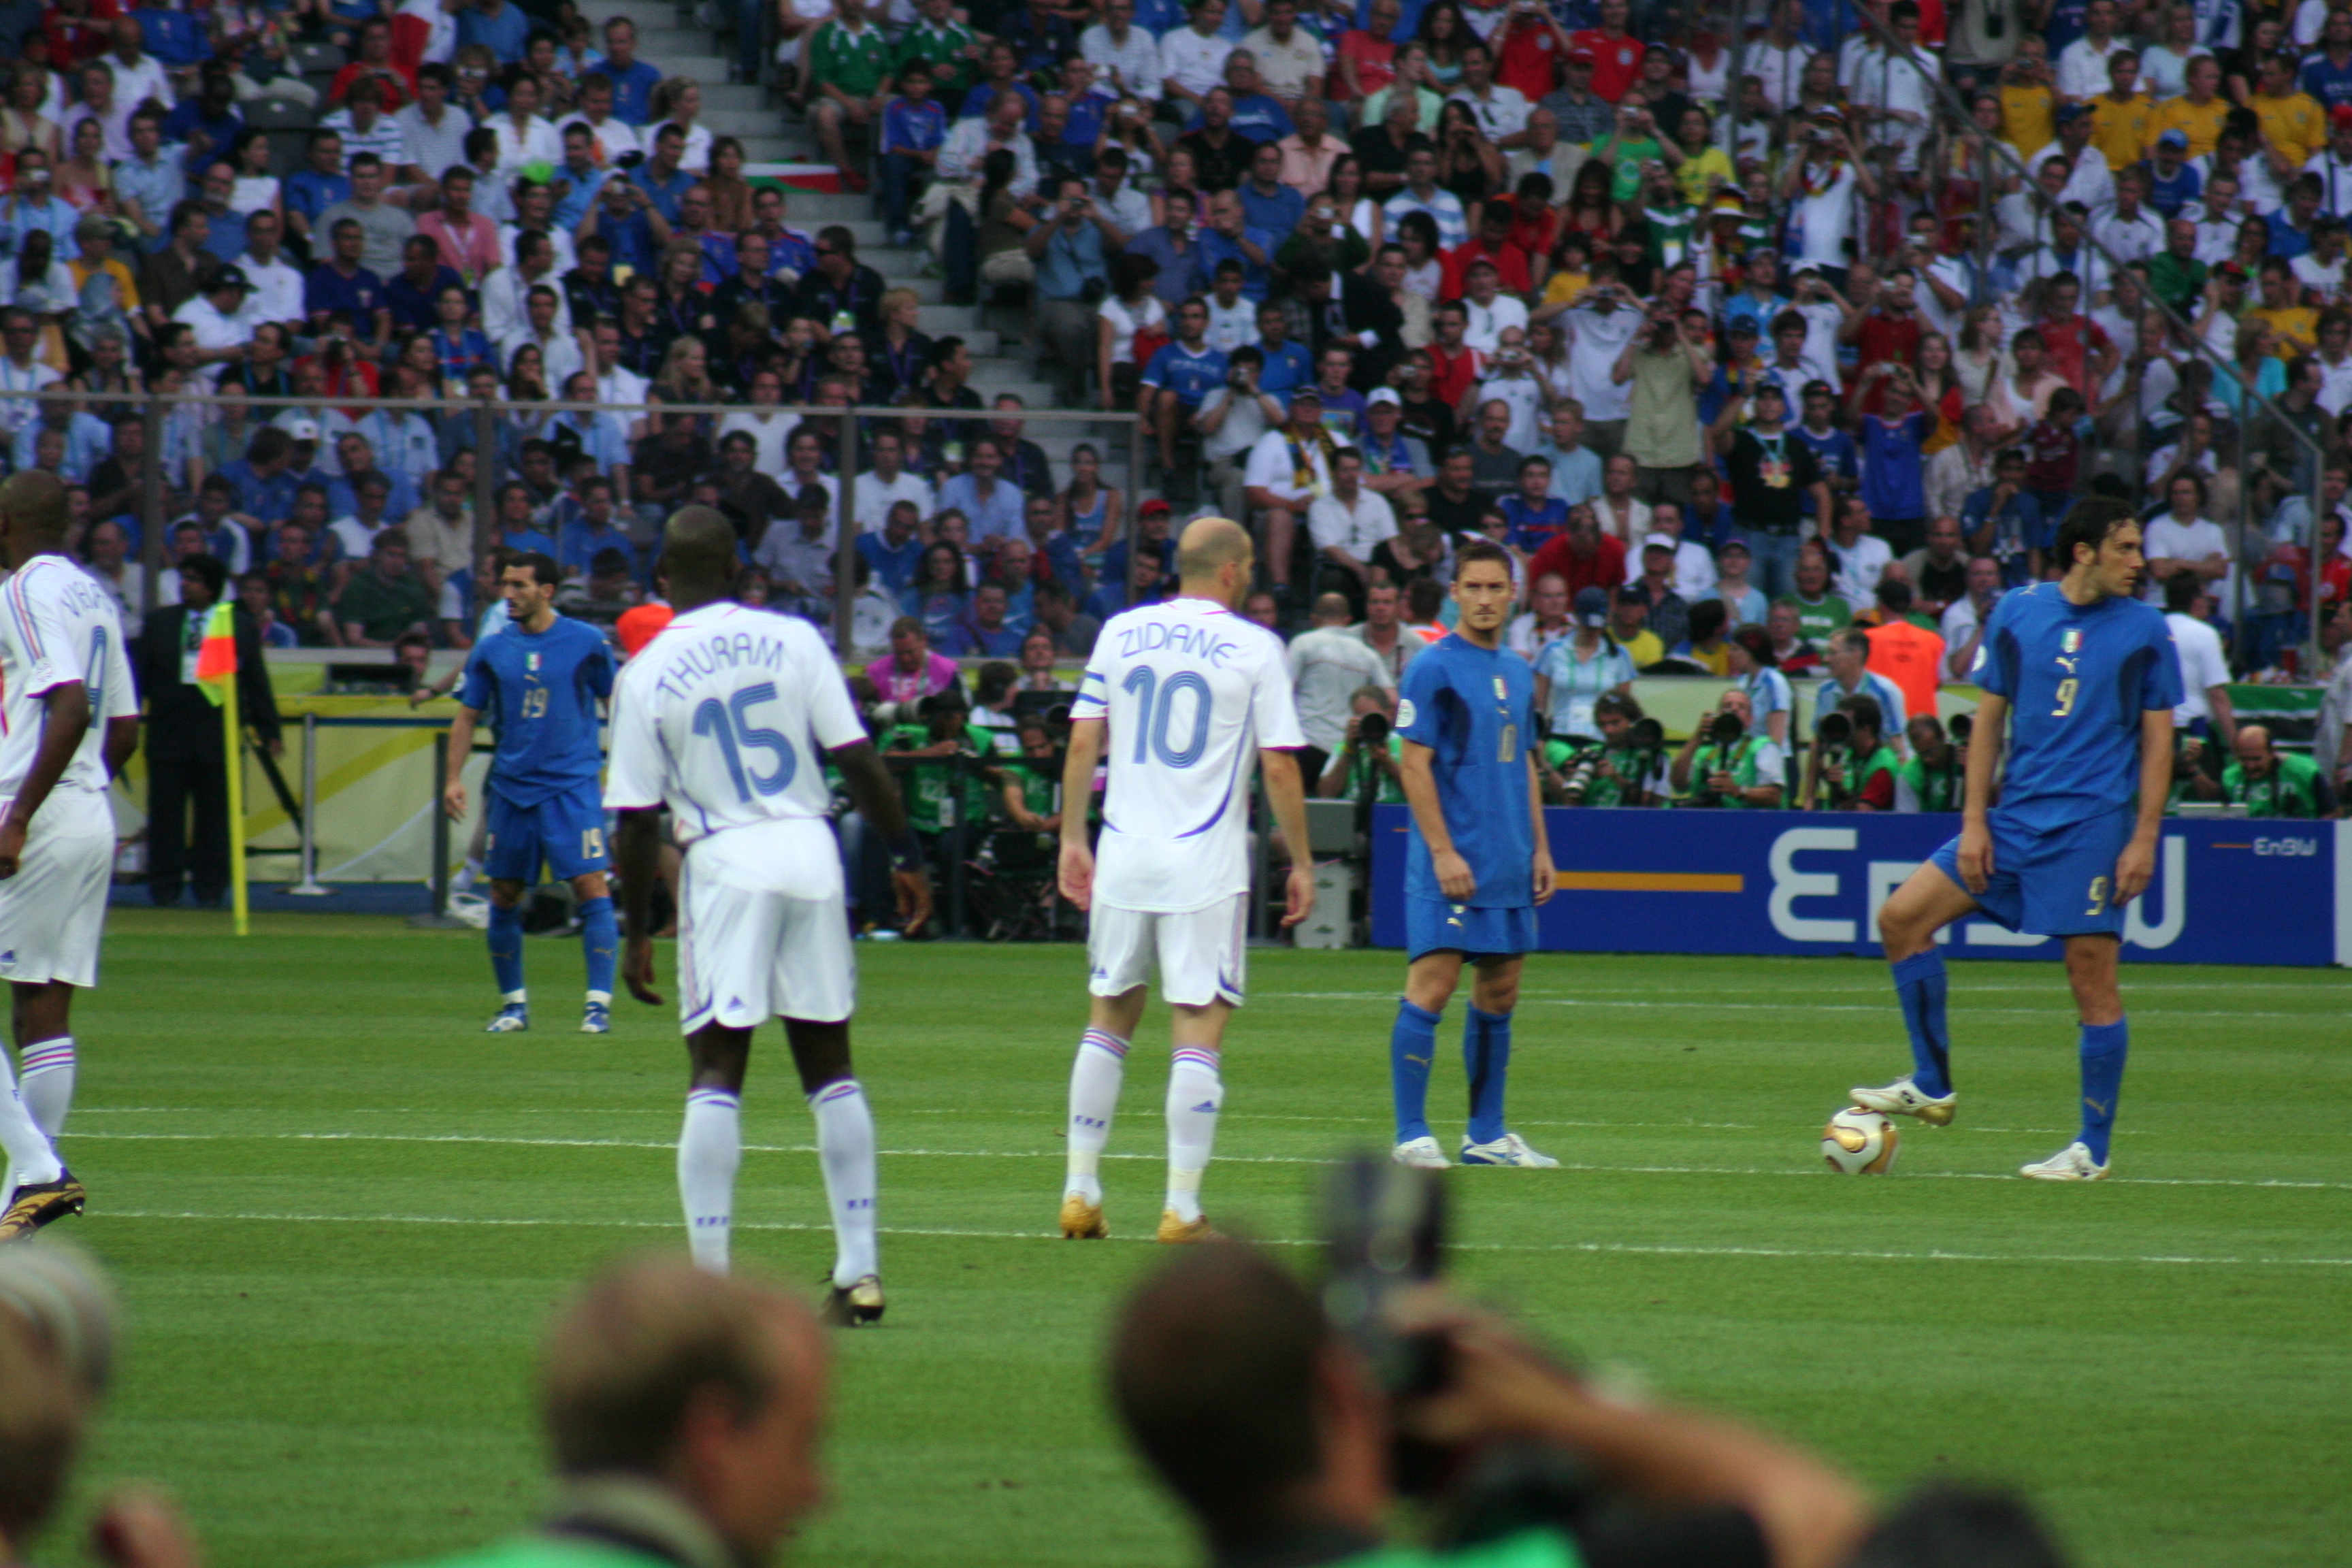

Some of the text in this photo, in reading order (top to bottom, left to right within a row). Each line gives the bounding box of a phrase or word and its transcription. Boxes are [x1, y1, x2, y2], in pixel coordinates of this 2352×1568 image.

[656, 632, 783, 700] THURAM
[1117, 622, 1238, 669] ZIDANE
[521, 688, 549, 719] 19
[1120, 665, 1212, 769] 10
[2052, 679, 2079, 716] 9
[692, 681, 797, 804] 15
[582, 828, 605, 860] 19
[2085, 876, 2108, 916] 9
